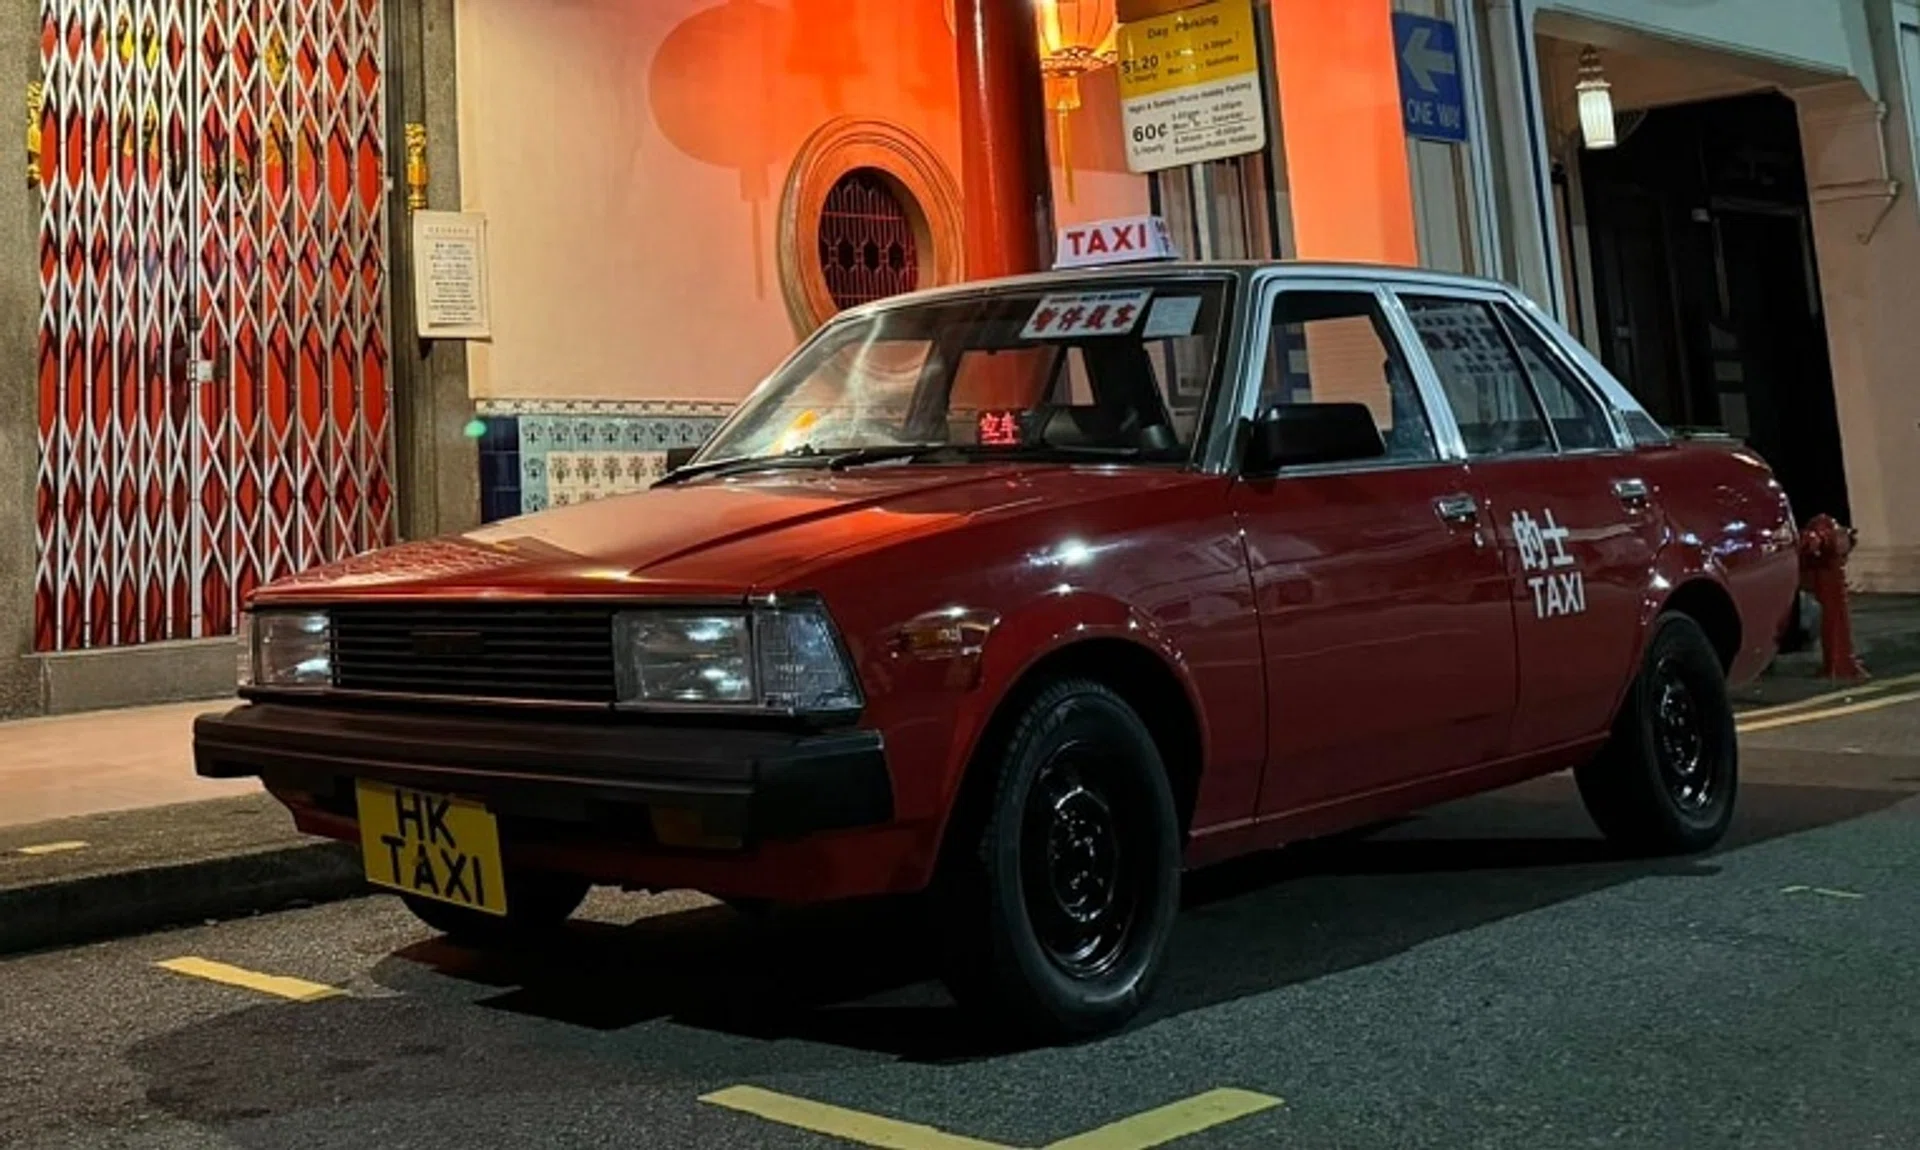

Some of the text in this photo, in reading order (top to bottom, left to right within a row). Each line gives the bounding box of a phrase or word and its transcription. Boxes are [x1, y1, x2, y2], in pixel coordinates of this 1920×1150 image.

[1147, 15, 1218, 39] Day Parking
[1067, 223, 1147, 256] TAXI
[1511, 508, 1574, 570] 的士
[1528, 571, 1586, 619] TAXI
[395, 788, 457, 850] HK
[380, 834, 484, 906] TAXI
